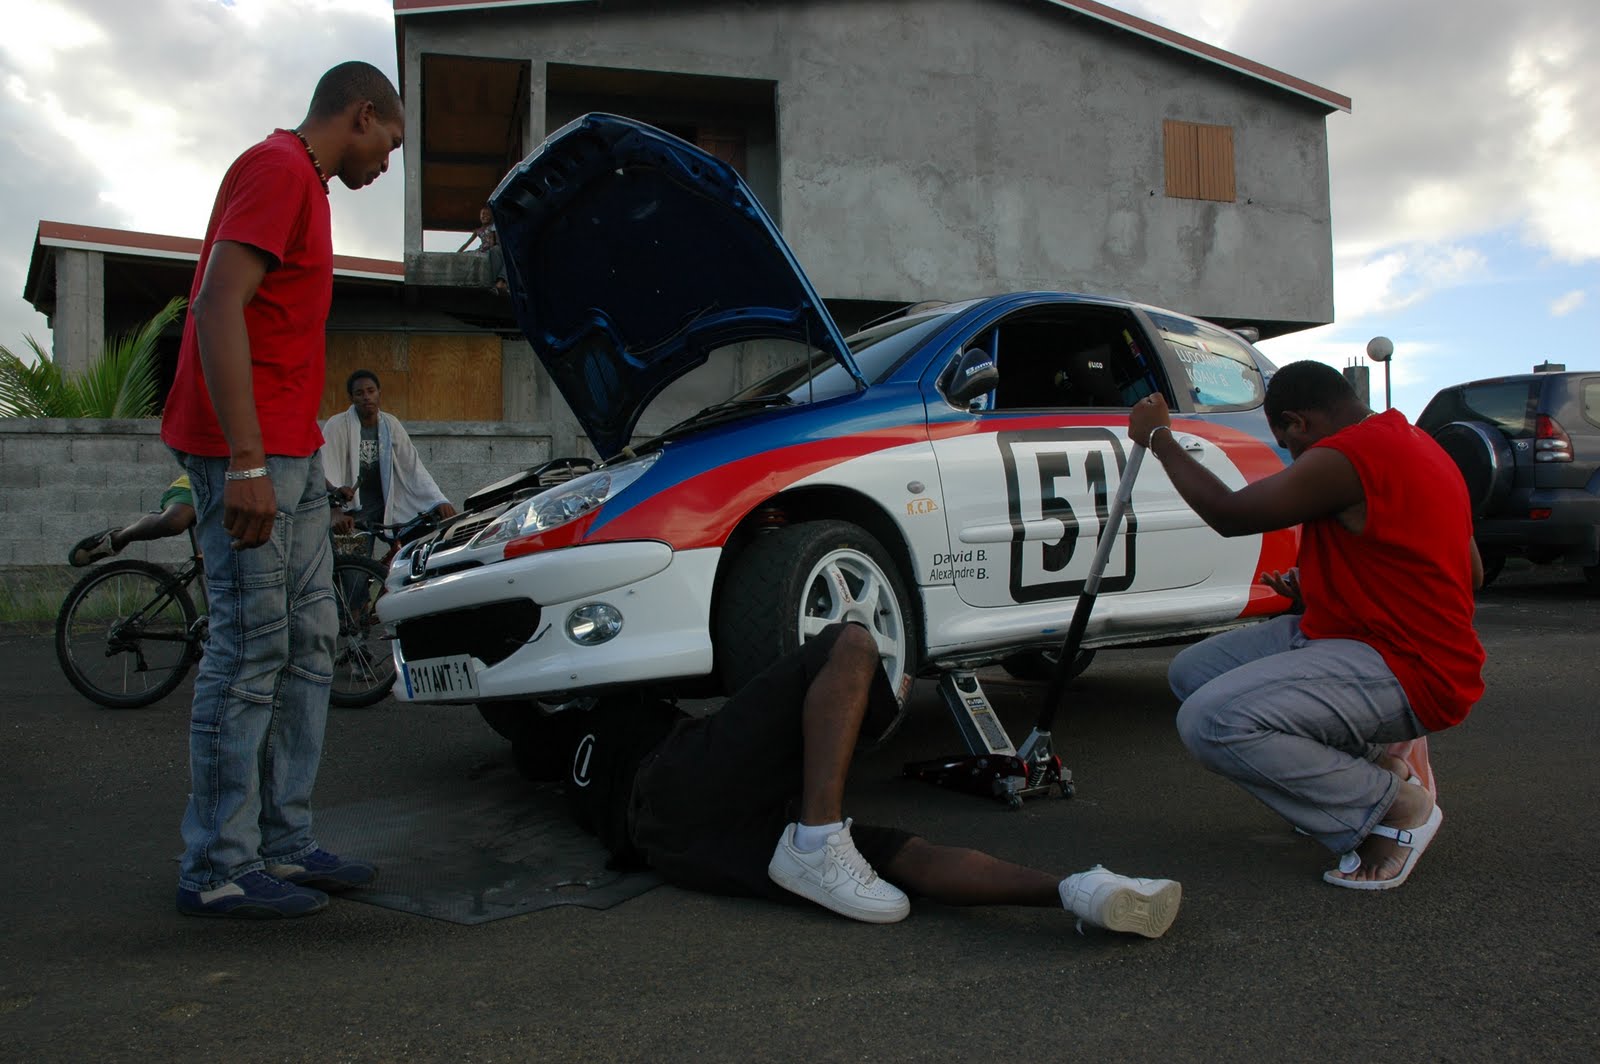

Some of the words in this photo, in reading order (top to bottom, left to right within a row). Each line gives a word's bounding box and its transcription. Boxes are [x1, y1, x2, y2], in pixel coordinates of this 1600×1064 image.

[1035, 450, 1110, 572] 51
[933, 549, 973, 566] David
[977, 549, 988, 561] B.
[929, 567, 975, 581] Alexandre
[977, 567, 990, 580] B.
